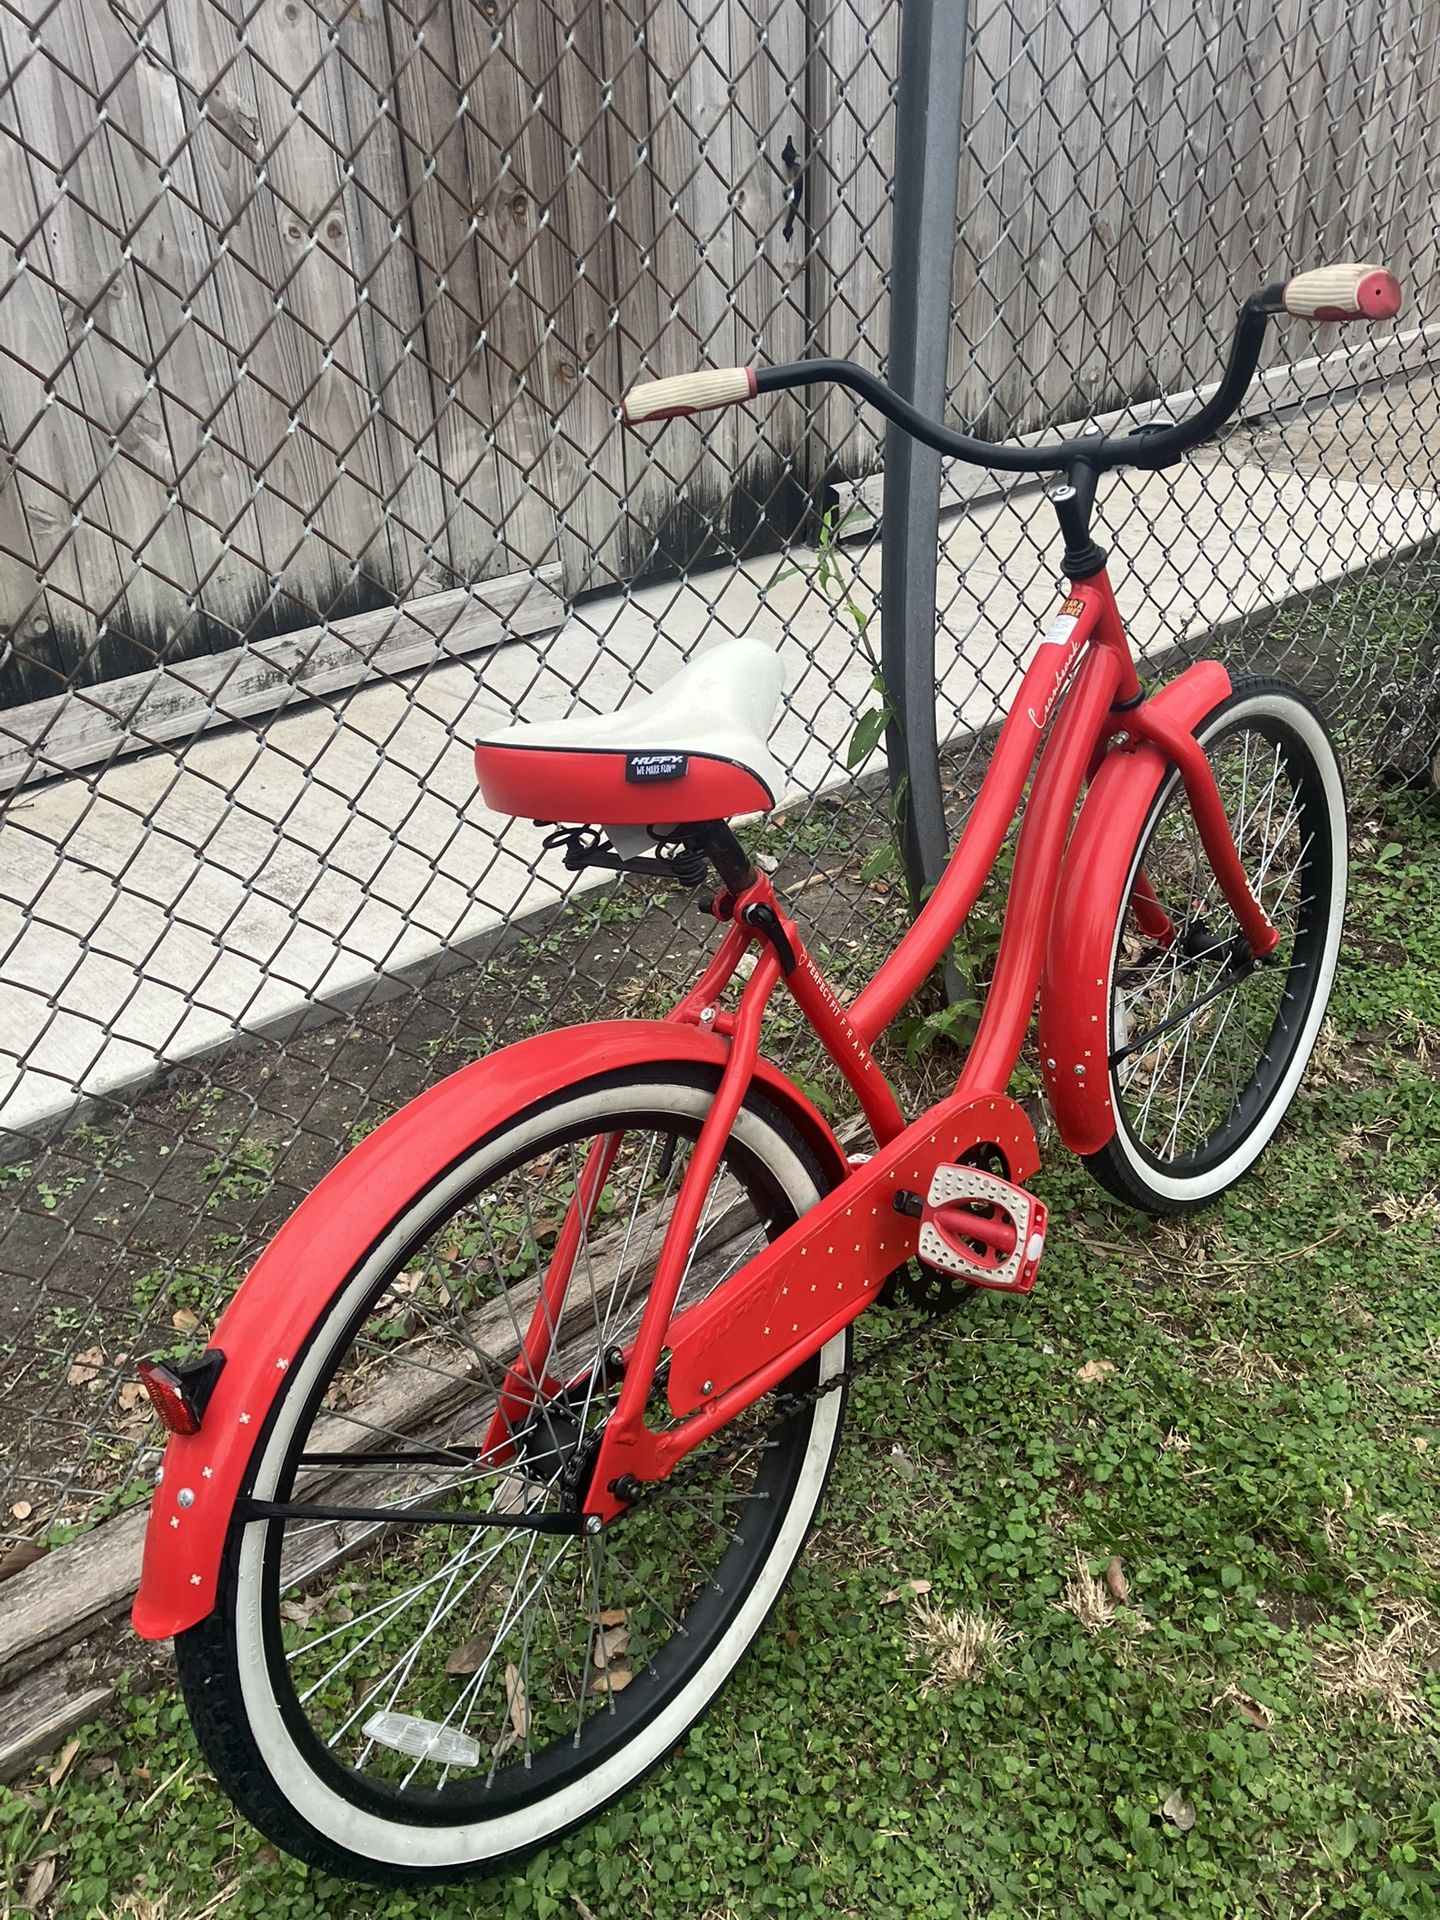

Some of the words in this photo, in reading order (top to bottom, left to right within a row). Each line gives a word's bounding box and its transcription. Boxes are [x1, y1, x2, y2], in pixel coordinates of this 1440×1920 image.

[636, 765, 645, 775] WE
[645, 765, 660, 775] MAKE
[806, 960, 833, 1002] PERFECT
[829, 1001, 841, 1017] FIT
[840, 1018, 872, 1070] FRAME
